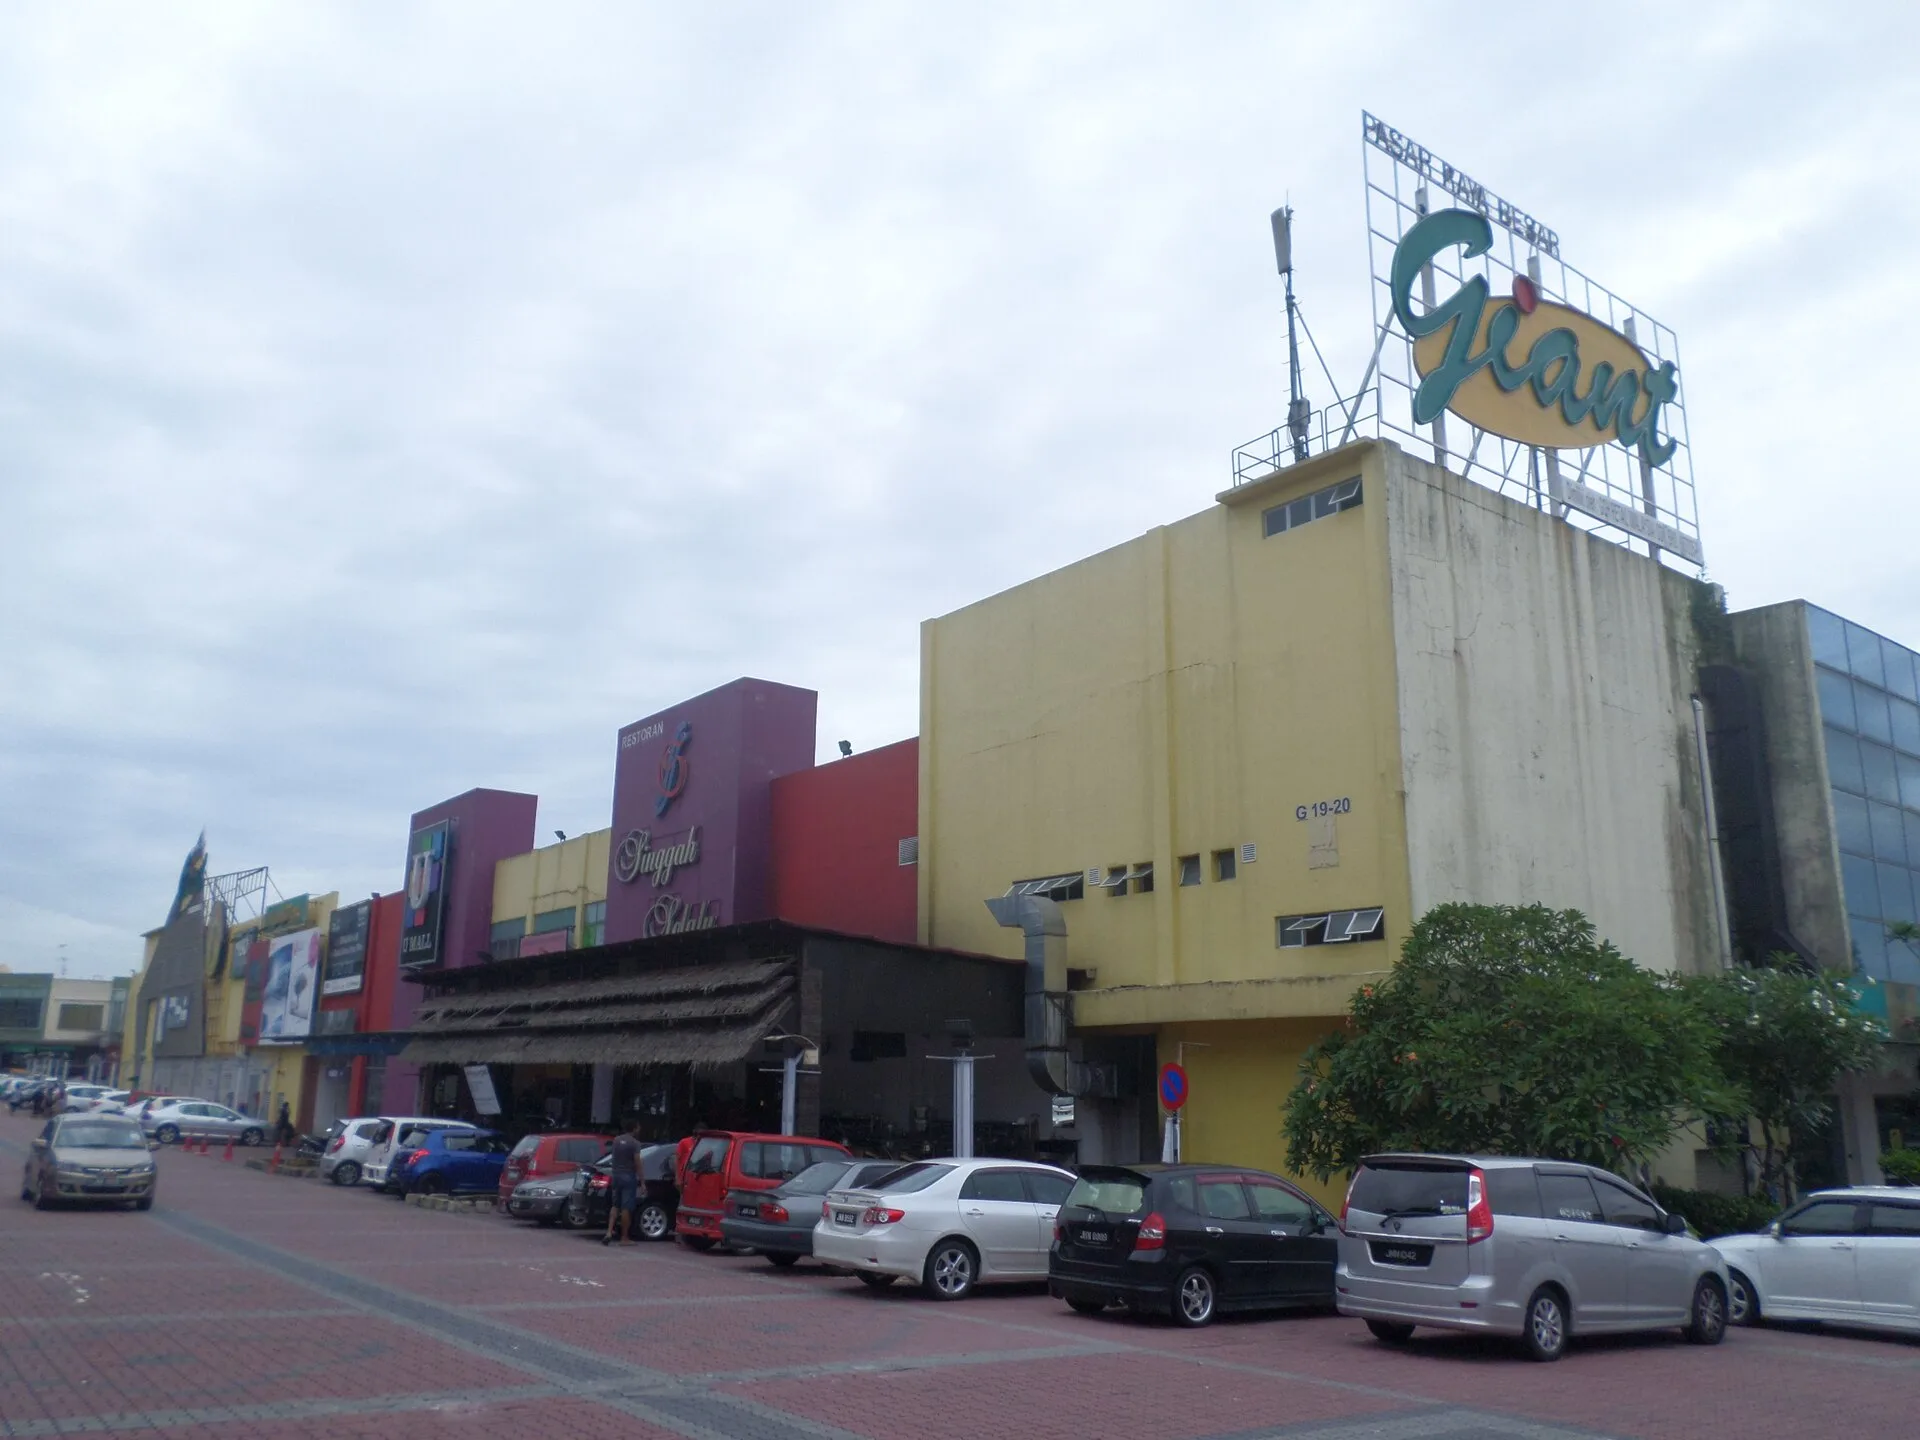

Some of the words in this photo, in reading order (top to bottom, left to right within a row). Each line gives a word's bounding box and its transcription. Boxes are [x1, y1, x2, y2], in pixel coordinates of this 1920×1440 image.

[1364, 111, 1431, 178] PASAR
[1442, 160, 1488, 216] RAYA
[1498, 198, 1560, 260] BESAR
[1391, 208, 1678, 468] Giant
[621, 720, 664, 749] RESTORAN
[1296, 805, 1307, 820] G
[1311, 797, 1350, 817] 19-20
[614, 825, 698, 887] Singgah
[410, 933, 432, 951] MALL
